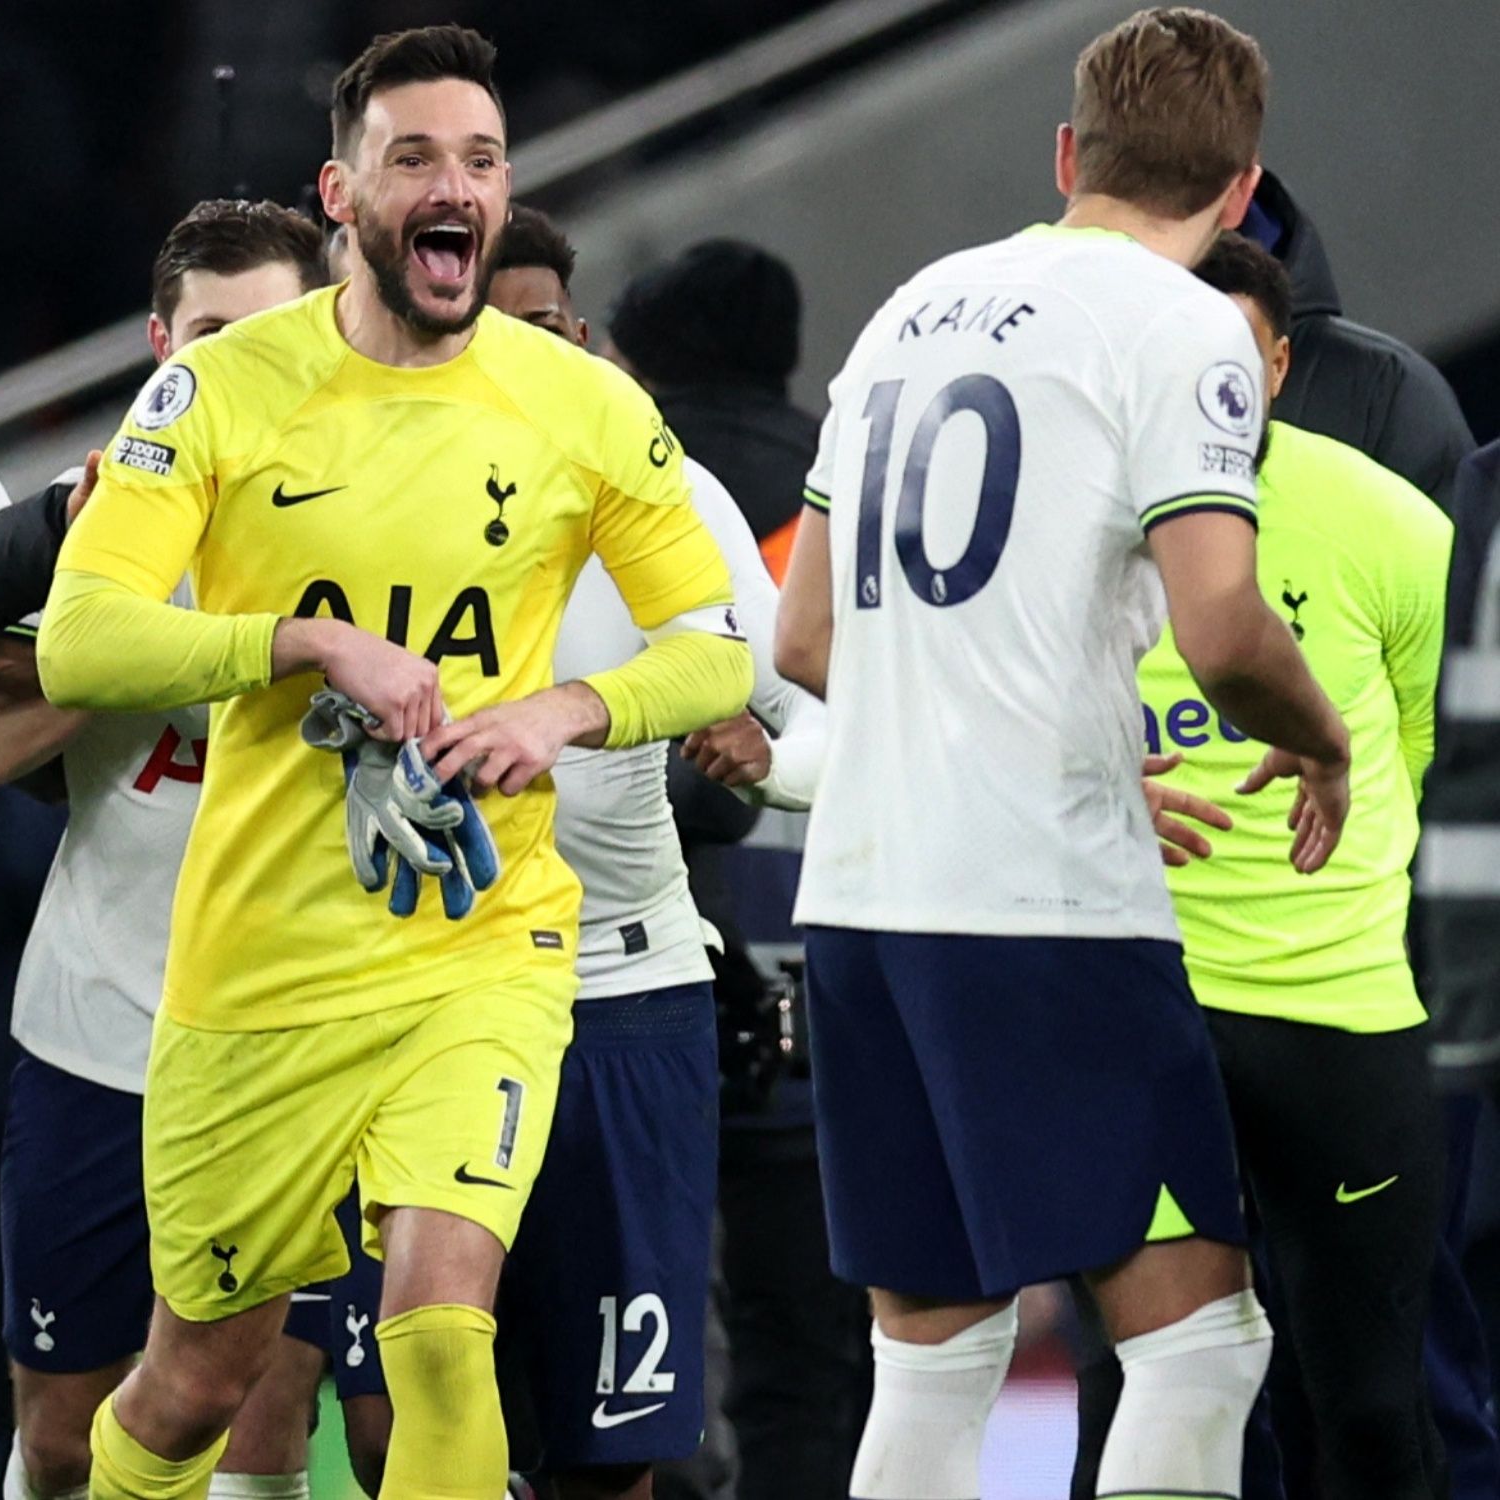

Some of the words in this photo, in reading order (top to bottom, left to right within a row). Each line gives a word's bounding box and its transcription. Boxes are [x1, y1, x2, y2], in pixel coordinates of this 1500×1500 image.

[898, 296, 1036, 344] KANE
[855, 373, 1022, 609] 10
[495, 1077, 523, 1170] 1
[596, 1293, 676, 1394] 12
